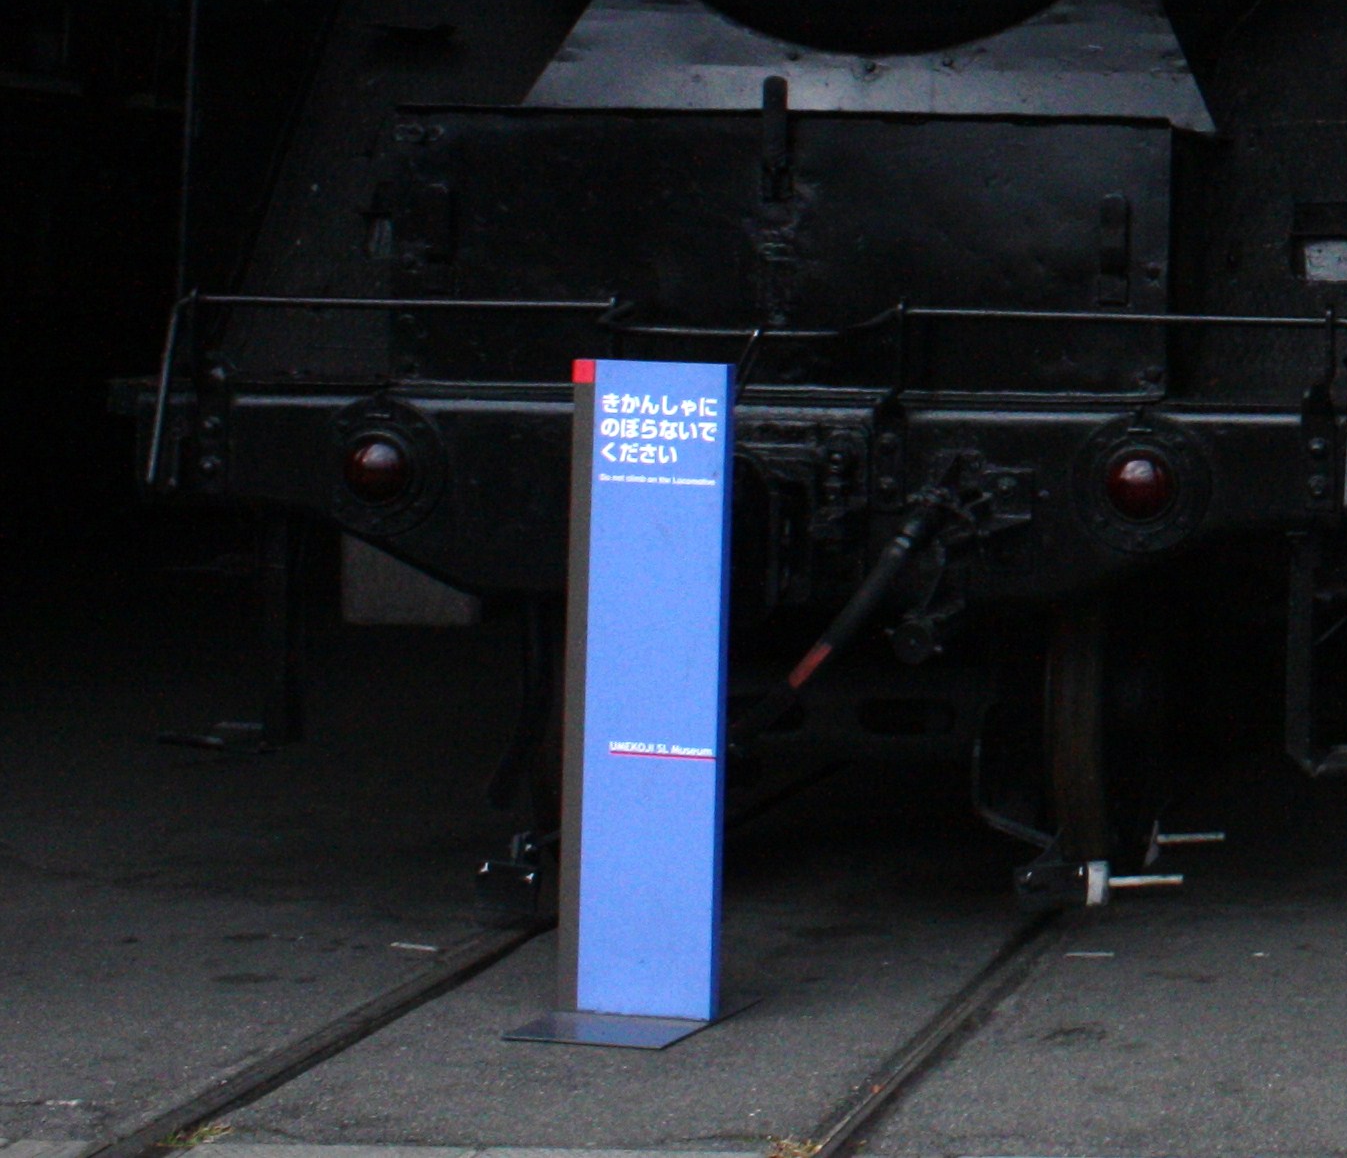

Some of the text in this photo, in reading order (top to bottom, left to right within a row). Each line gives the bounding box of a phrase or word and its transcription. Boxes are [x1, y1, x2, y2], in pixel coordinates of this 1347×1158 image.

[602, 393, 718, 417] きかんしゃに
[600, 418, 718, 442] のぼらないで
[601, 442, 678, 464] ください
[656, 743, 669, 754] SL
